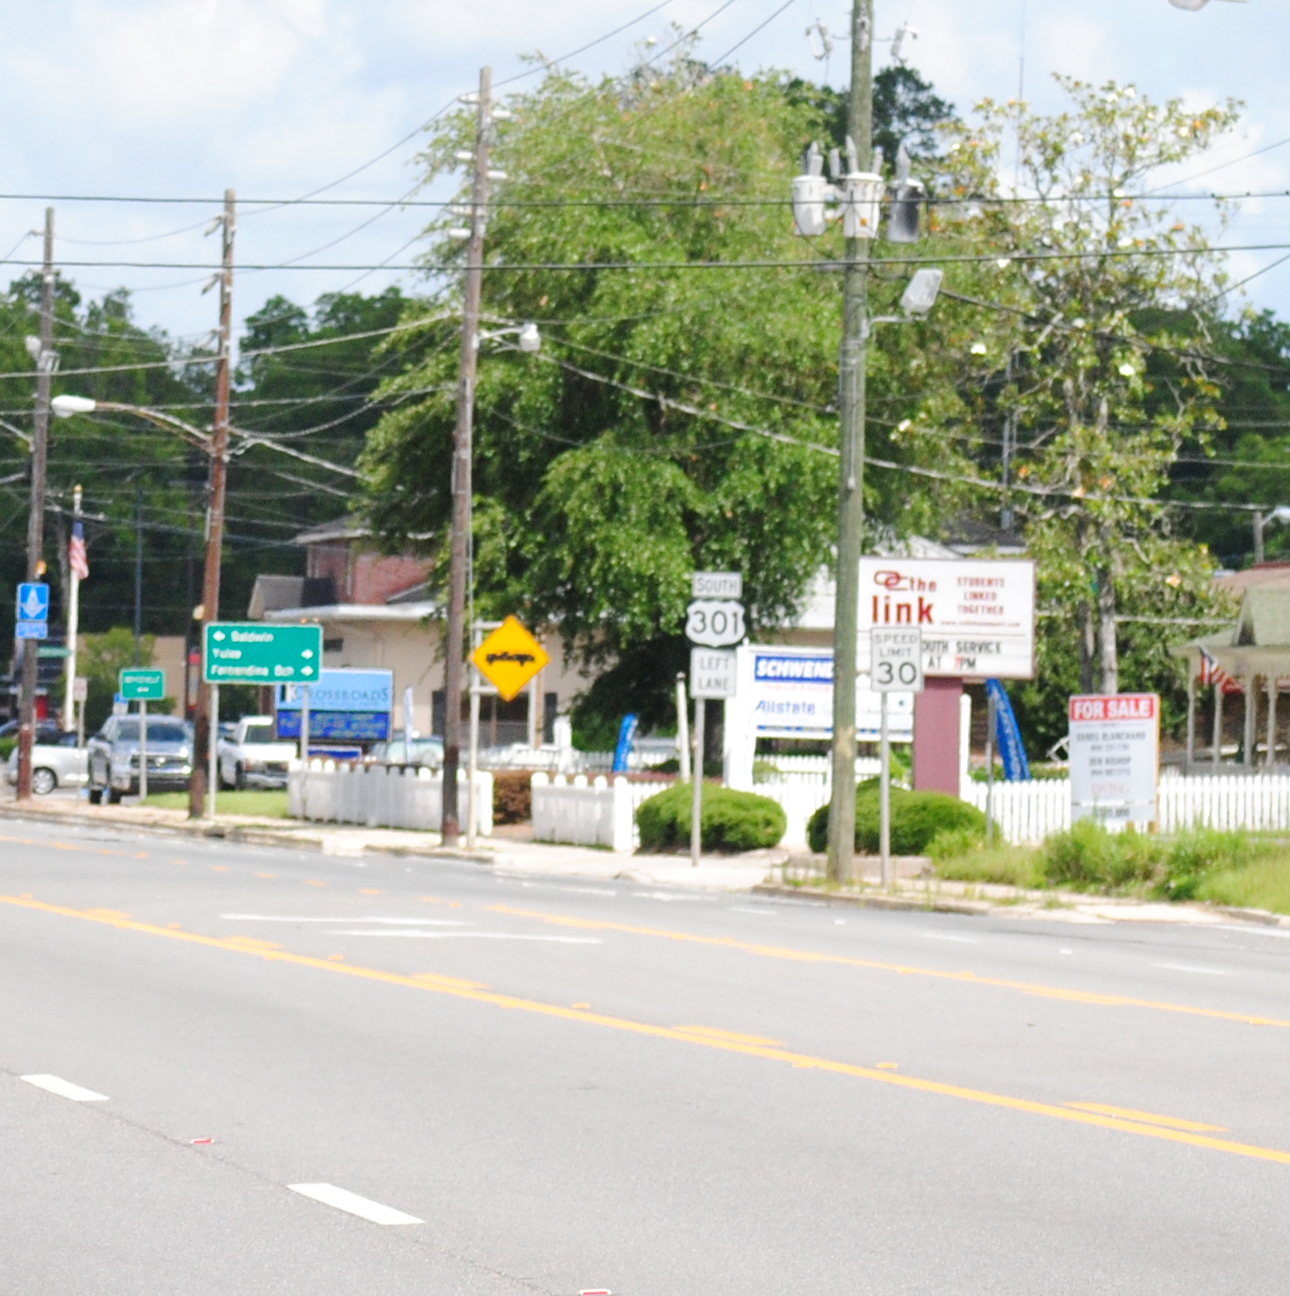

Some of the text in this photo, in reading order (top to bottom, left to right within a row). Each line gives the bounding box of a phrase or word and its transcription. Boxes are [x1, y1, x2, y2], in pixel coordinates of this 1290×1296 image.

[697, 577, 737, 592] SOUTH
[910, 577, 938, 592] the
[957, 577, 1005, 587] STUDENTS
[964, 591, 997, 600] LINKED
[872, 595, 935, 624] link
[957, 605, 1004, 615] TOGETHER
[692, 610, 738, 635] 301
[230, 630, 274, 642] Baldwin
[874, 634, 918, 645] SPEED
[879, 648, 912, 658] LIMIT
[921, 641, 1002, 654] OUTH SERVICE
[700, 658, 729, 670] LEFT
[928, 656, 943, 669] AT
[877, 661, 917, 685] 30
[698, 678, 729, 690] LANE
[754, 700, 816, 715] Allstate
[1074, 698, 1151, 720] FOR SALE
